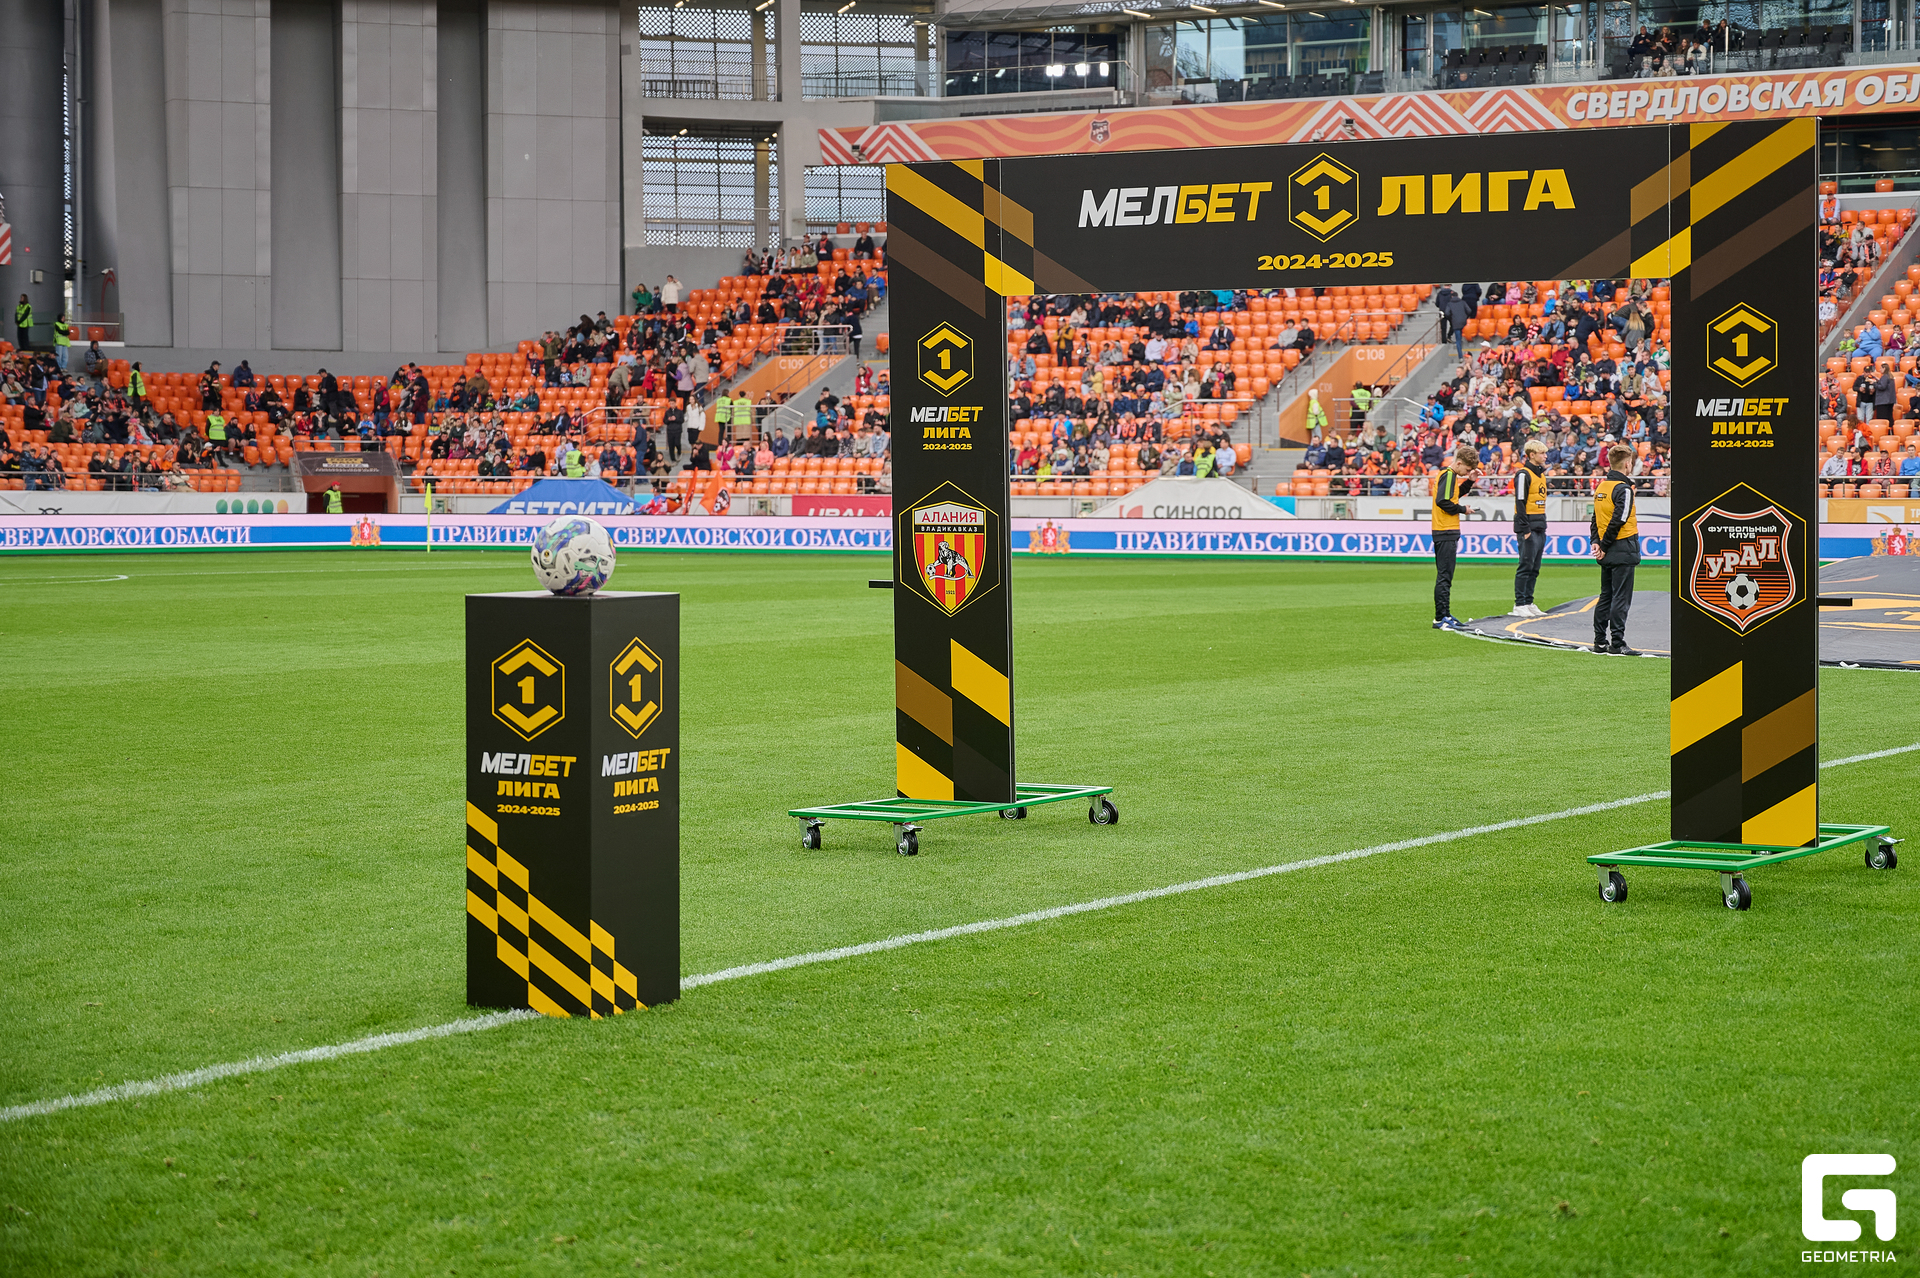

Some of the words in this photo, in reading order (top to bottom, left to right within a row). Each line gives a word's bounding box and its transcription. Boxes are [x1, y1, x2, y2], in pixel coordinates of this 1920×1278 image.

[1566, 79, 1847, 121] СВЕРДЛОВСКАЯ
[1078, 182, 1273, 227] МЕЛБЕТ
[1377, 169, 1576, 217] ЛИГА
[1257, 252, 1394, 271] 2024-2025
[910, 406, 983, 423] МЕЛБЕТ
[1695, 398, 1789, 416] МЕЛБЕТ
[922, 427, 972, 439] ЛИГА
[1711, 421, 1773, 435] ЛИГА
[922, 443, 973, 451] 2024-2025
[1710, 440, 1775, 448] 2024-2025
[921, 511, 978, 523] АЛАНИЯ
[160, 526, 251, 545] ОБЛАСТИ
[920, 525, 978, 533] ВЛАДИКАВКАЗ
[1707, 525, 1777, 533] ФУТБОЛЬНЫЙ
[1115, 531, 1335, 552] ПРАВИТЕЛЬСТВО
[1704, 537, 1779, 579] УРАЛ
[480, 752, 577, 778] МЕЛБЕТ
[601, 748, 671, 778] МЕЛБЕТ
[496, 780, 561, 800] ЛИГА
[613, 777, 660, 798] ЛИГА
[496, 803, 561, 817] 2024-2025
[612, 799, 660, 815] 2024-2025
